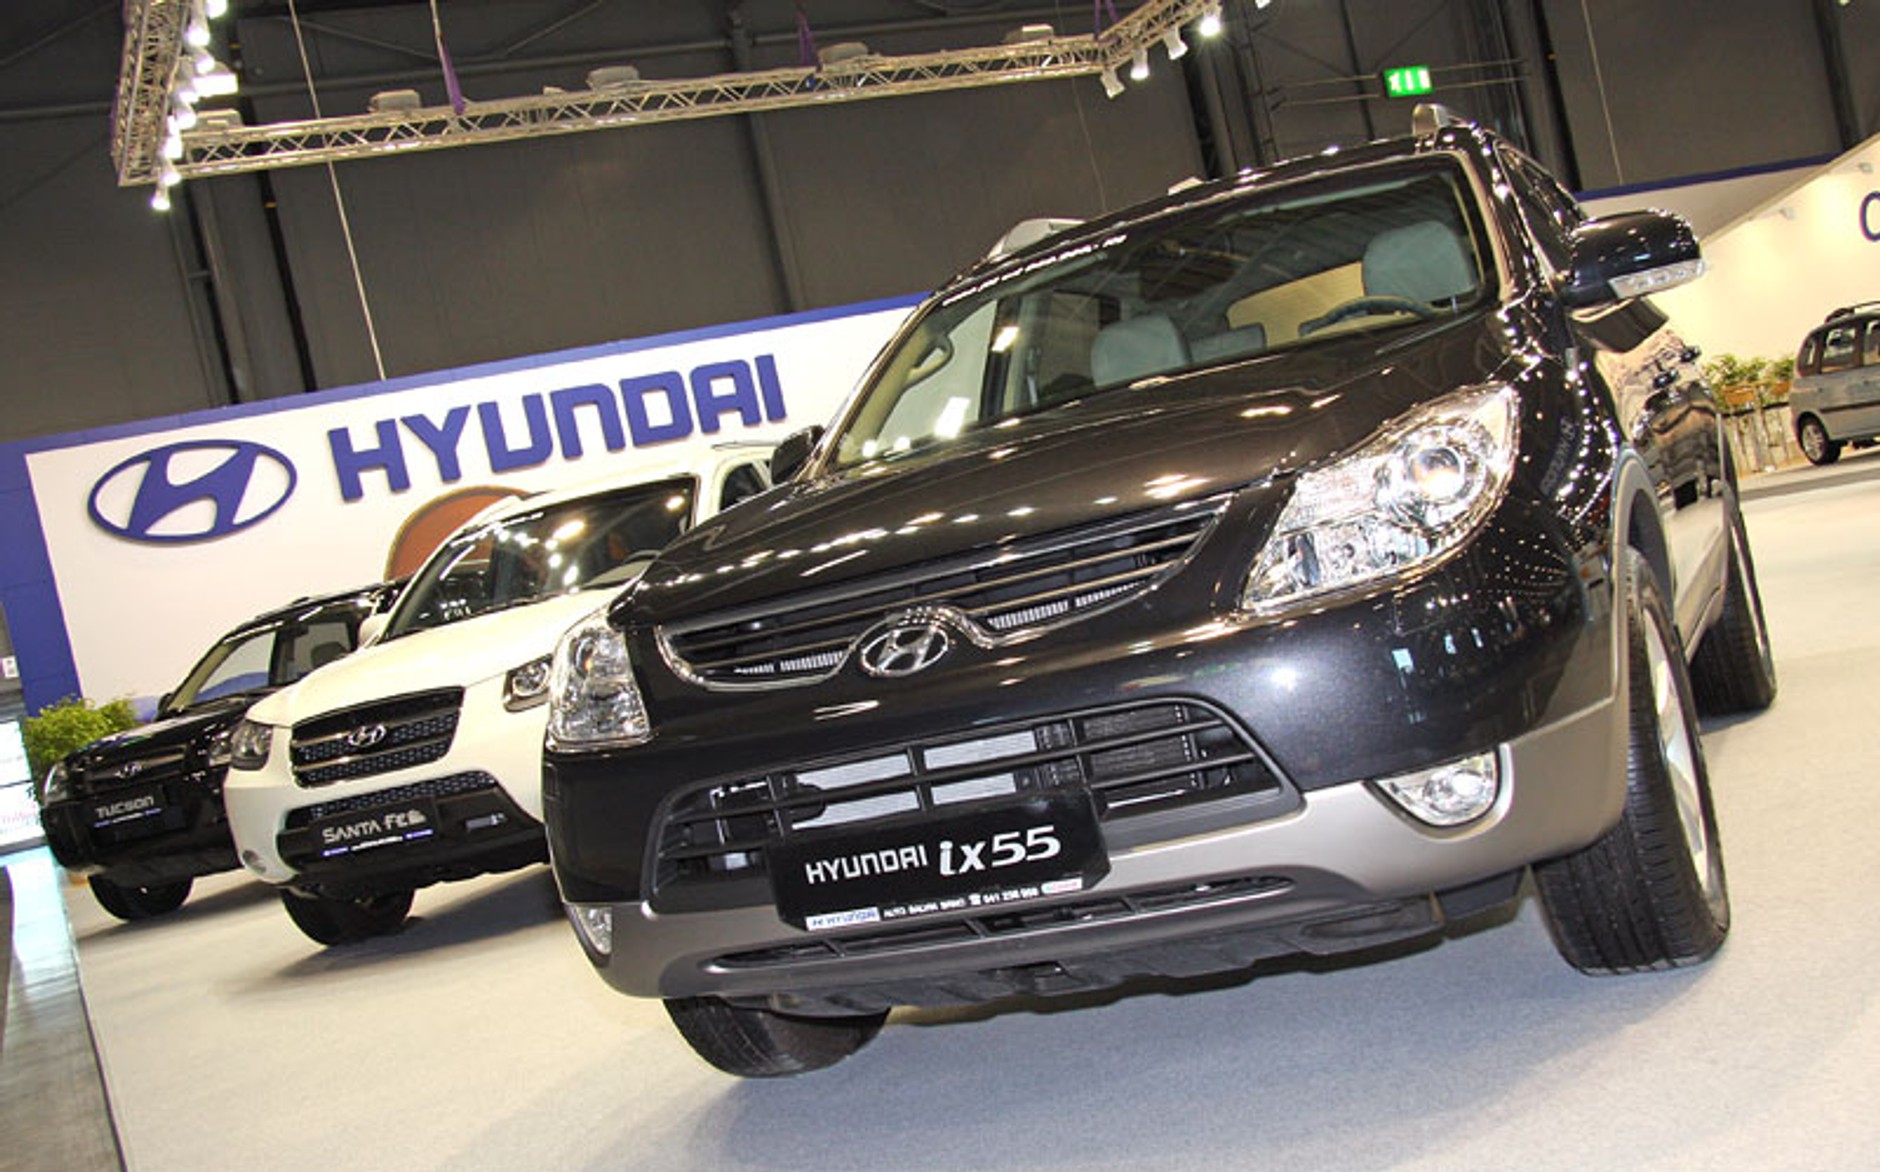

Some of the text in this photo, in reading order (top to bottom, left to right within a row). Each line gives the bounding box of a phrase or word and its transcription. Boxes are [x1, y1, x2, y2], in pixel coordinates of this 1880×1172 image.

[327, 353, 787, 503] HYUNDAI
[95, 795, 155, 818] TUCSON
[322, 818, 382, 844] SANTA
[805, 825, 1062, 885] HYUNDAI ix55
